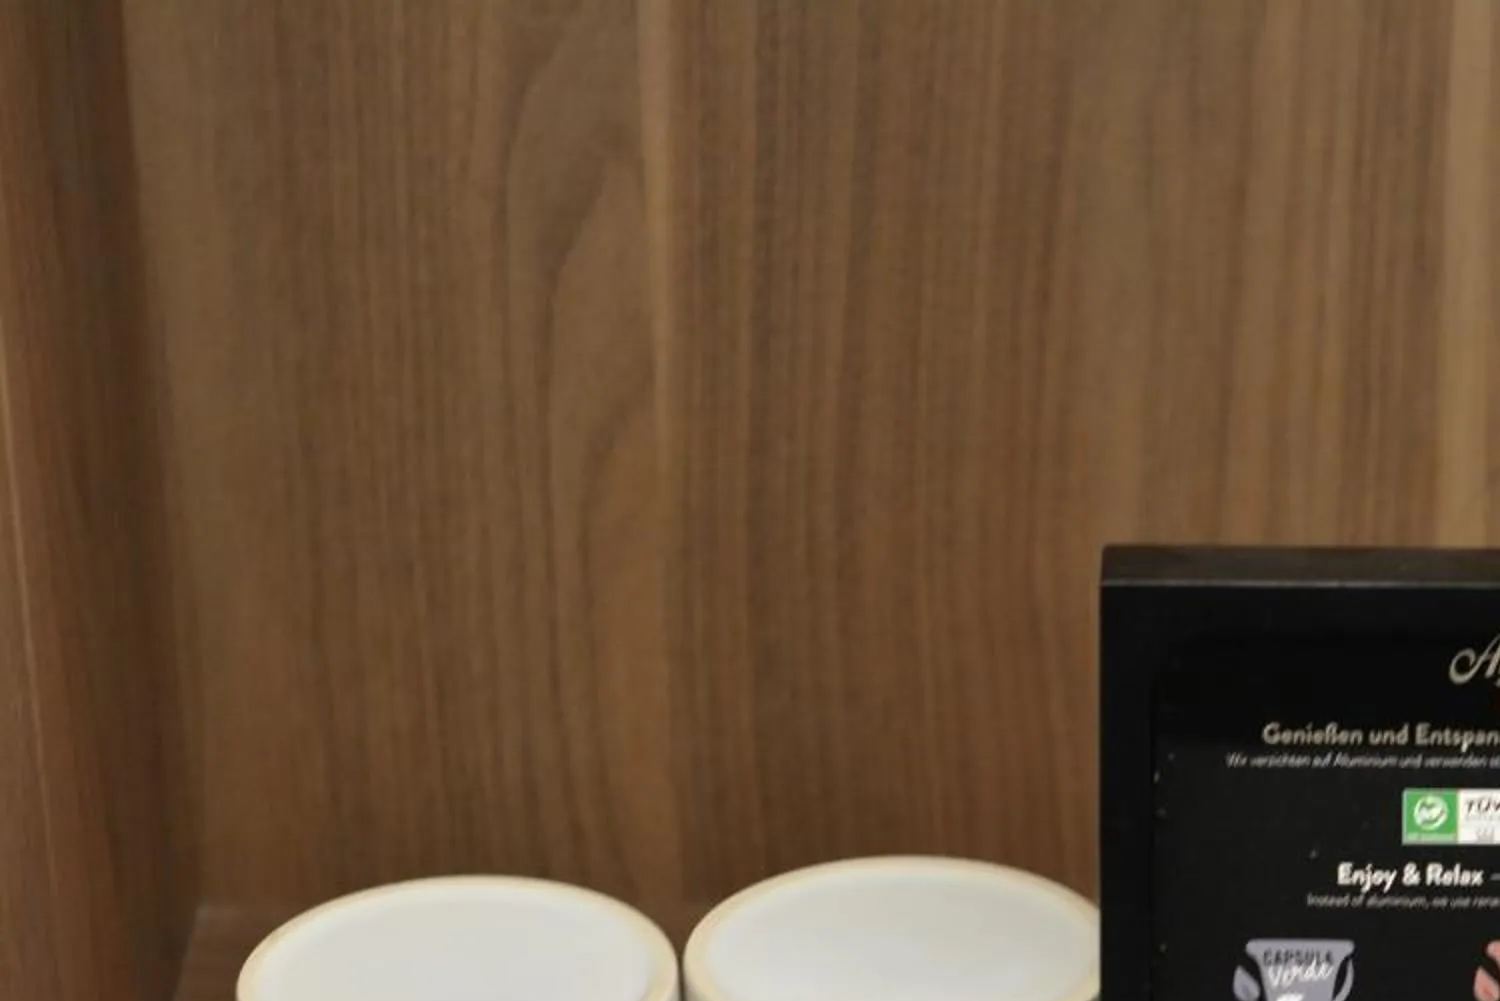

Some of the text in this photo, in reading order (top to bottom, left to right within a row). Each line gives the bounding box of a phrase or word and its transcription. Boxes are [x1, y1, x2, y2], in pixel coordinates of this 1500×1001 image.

[1262, 722, 1363, 745] Genießen
[1369, 723, 1408, 744] und
[1337, 862, 1397, 893] Enjoy
[1402, 862, 1420, 886] &
[1426, 862, 1484, 886] Relax
